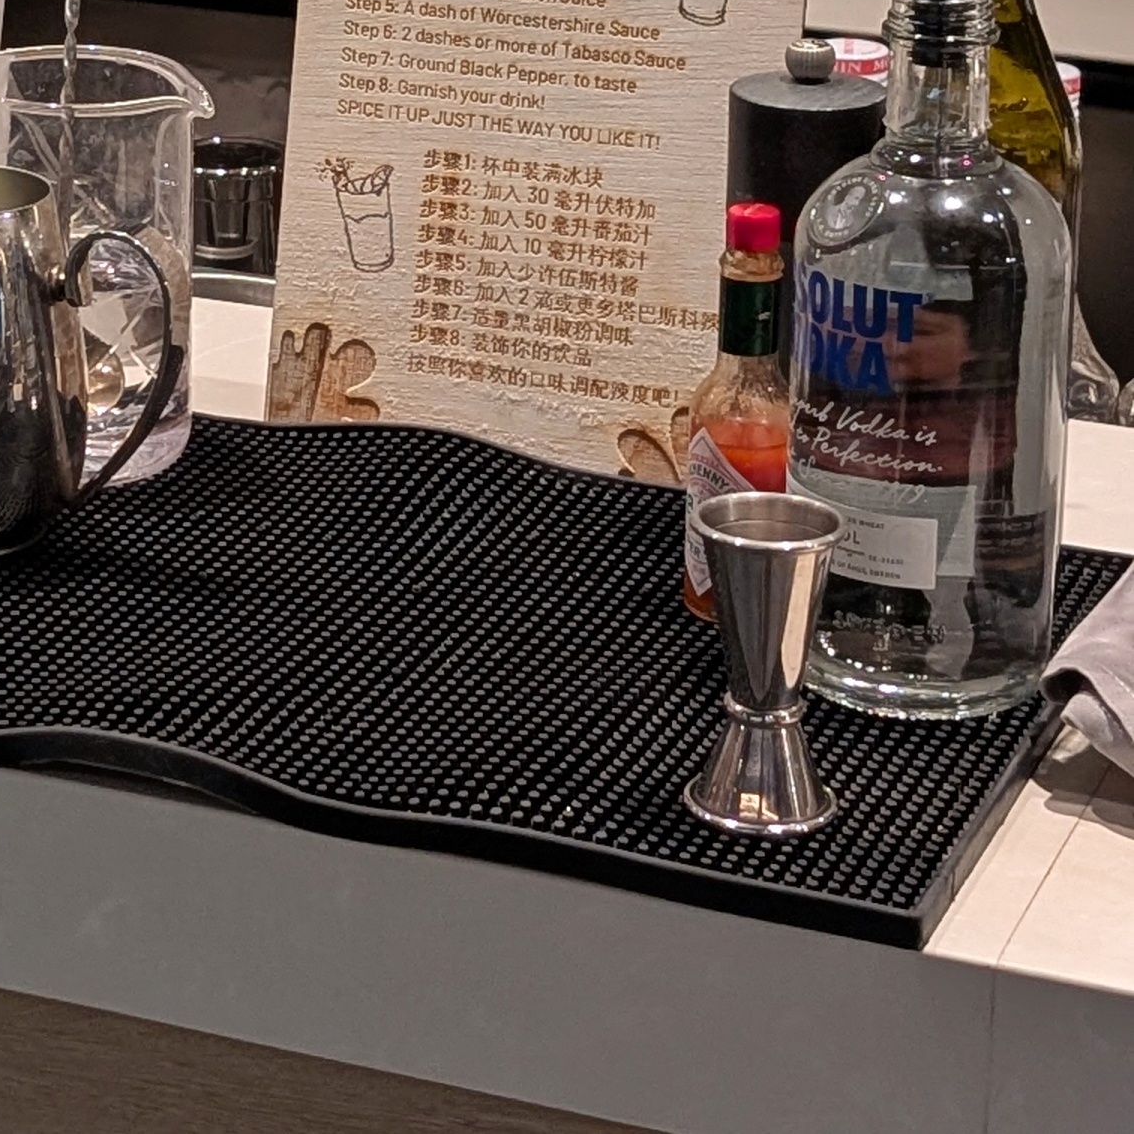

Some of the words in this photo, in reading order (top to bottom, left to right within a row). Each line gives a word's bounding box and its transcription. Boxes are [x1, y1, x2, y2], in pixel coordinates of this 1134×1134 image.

[403, 0, 415, 15] A
[419, 2, 456, 20] dash
[460, 6, 476, 22] of
[480, 7, 605, 35] Worcestershire
[609, 20, 661, 41] Sauce
[343, 20, 379, 39] Step
[383, 24, 397, 40] 6:
[401, 26, 411, 41] 2
[416, 28, 471, 49] dashes
[475, 36, 491, 50] or
[495, 39, 537, 56] more
[541, 42, 558, 57] of
[563, 42, 630, 65] Tabasco
[634, 50, 686, 71] Sauce
[341, 46, 377, 66] Step
[381, 50, 394, 66] 7:
[398, 53, 455, 73] Ground
[460, 59, 503, 78] Black
[573, 73, 590, 88] to
[594, 75, 637, 93] taste
[338, 72, 376, 92] Step
[379, 77, 393, 93] 8:
[398, 79, 457, 100] Garnish
[460, 88, 496, 105] your
[500, 91, 545, 110] drink!
[336, 99, 384, 118] SPICE
[406, 107, 429, 123] UP
[432, 111, 476, 128] JUST
[479, 115, 512, 133] THE
[517, 119, 555, 137] WAY
[560, 124, 592, 142] YOU
[597, 128, 635, 146] LIKE
[639, 133, 661, 150] IT!
[482, 181, 522, 204] 加入
[527, 186, 549, 205] 30
[480, 205, 519, 229] 加入
[524, 211, 547, 230] 50
[479, 230, 518, 254] 加入
[524, 237, 542, 255] 10
[474, 282, 514, 306] 加入
[518, 288, 529, 305] 2
[837, 406, 910, 442] Vodka
[915, 426, 937, 446] is
